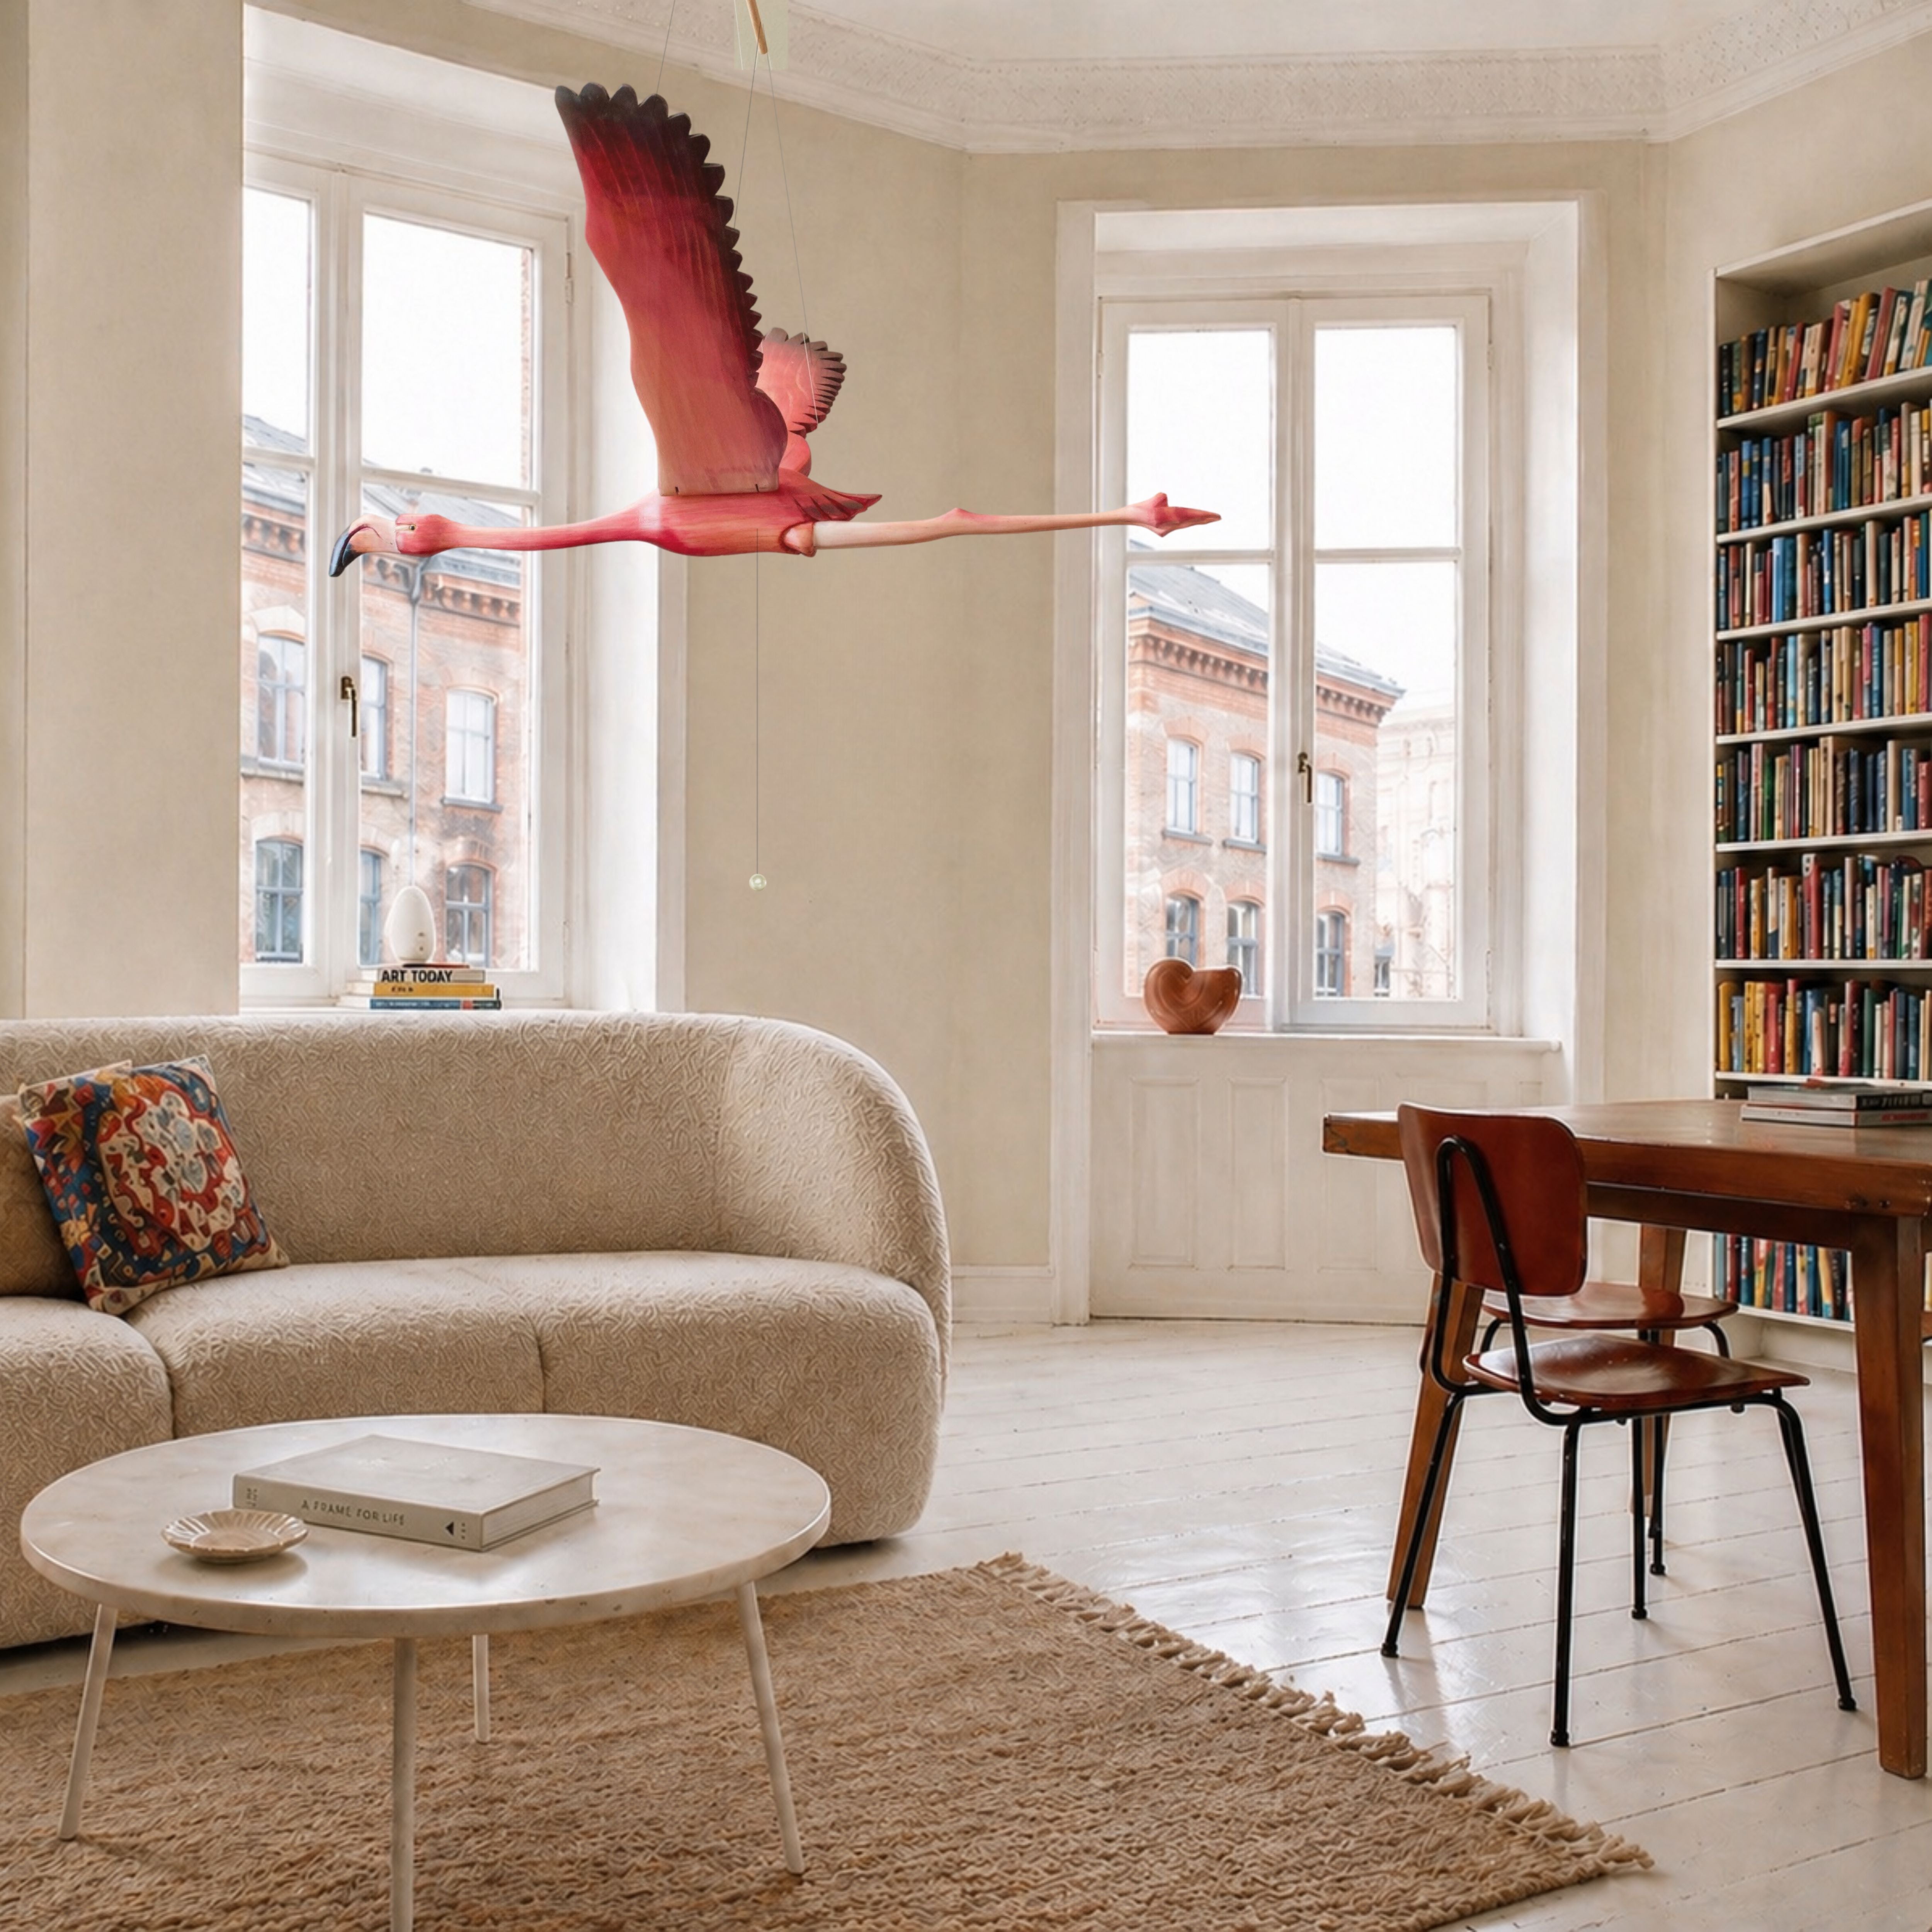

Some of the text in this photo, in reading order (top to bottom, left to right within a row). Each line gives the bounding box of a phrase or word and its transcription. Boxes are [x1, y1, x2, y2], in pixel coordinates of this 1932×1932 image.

[381, 970, 452, 983] ART TODAY
[301, 1500, 405, 1526] A FRAME FOR LIFE
